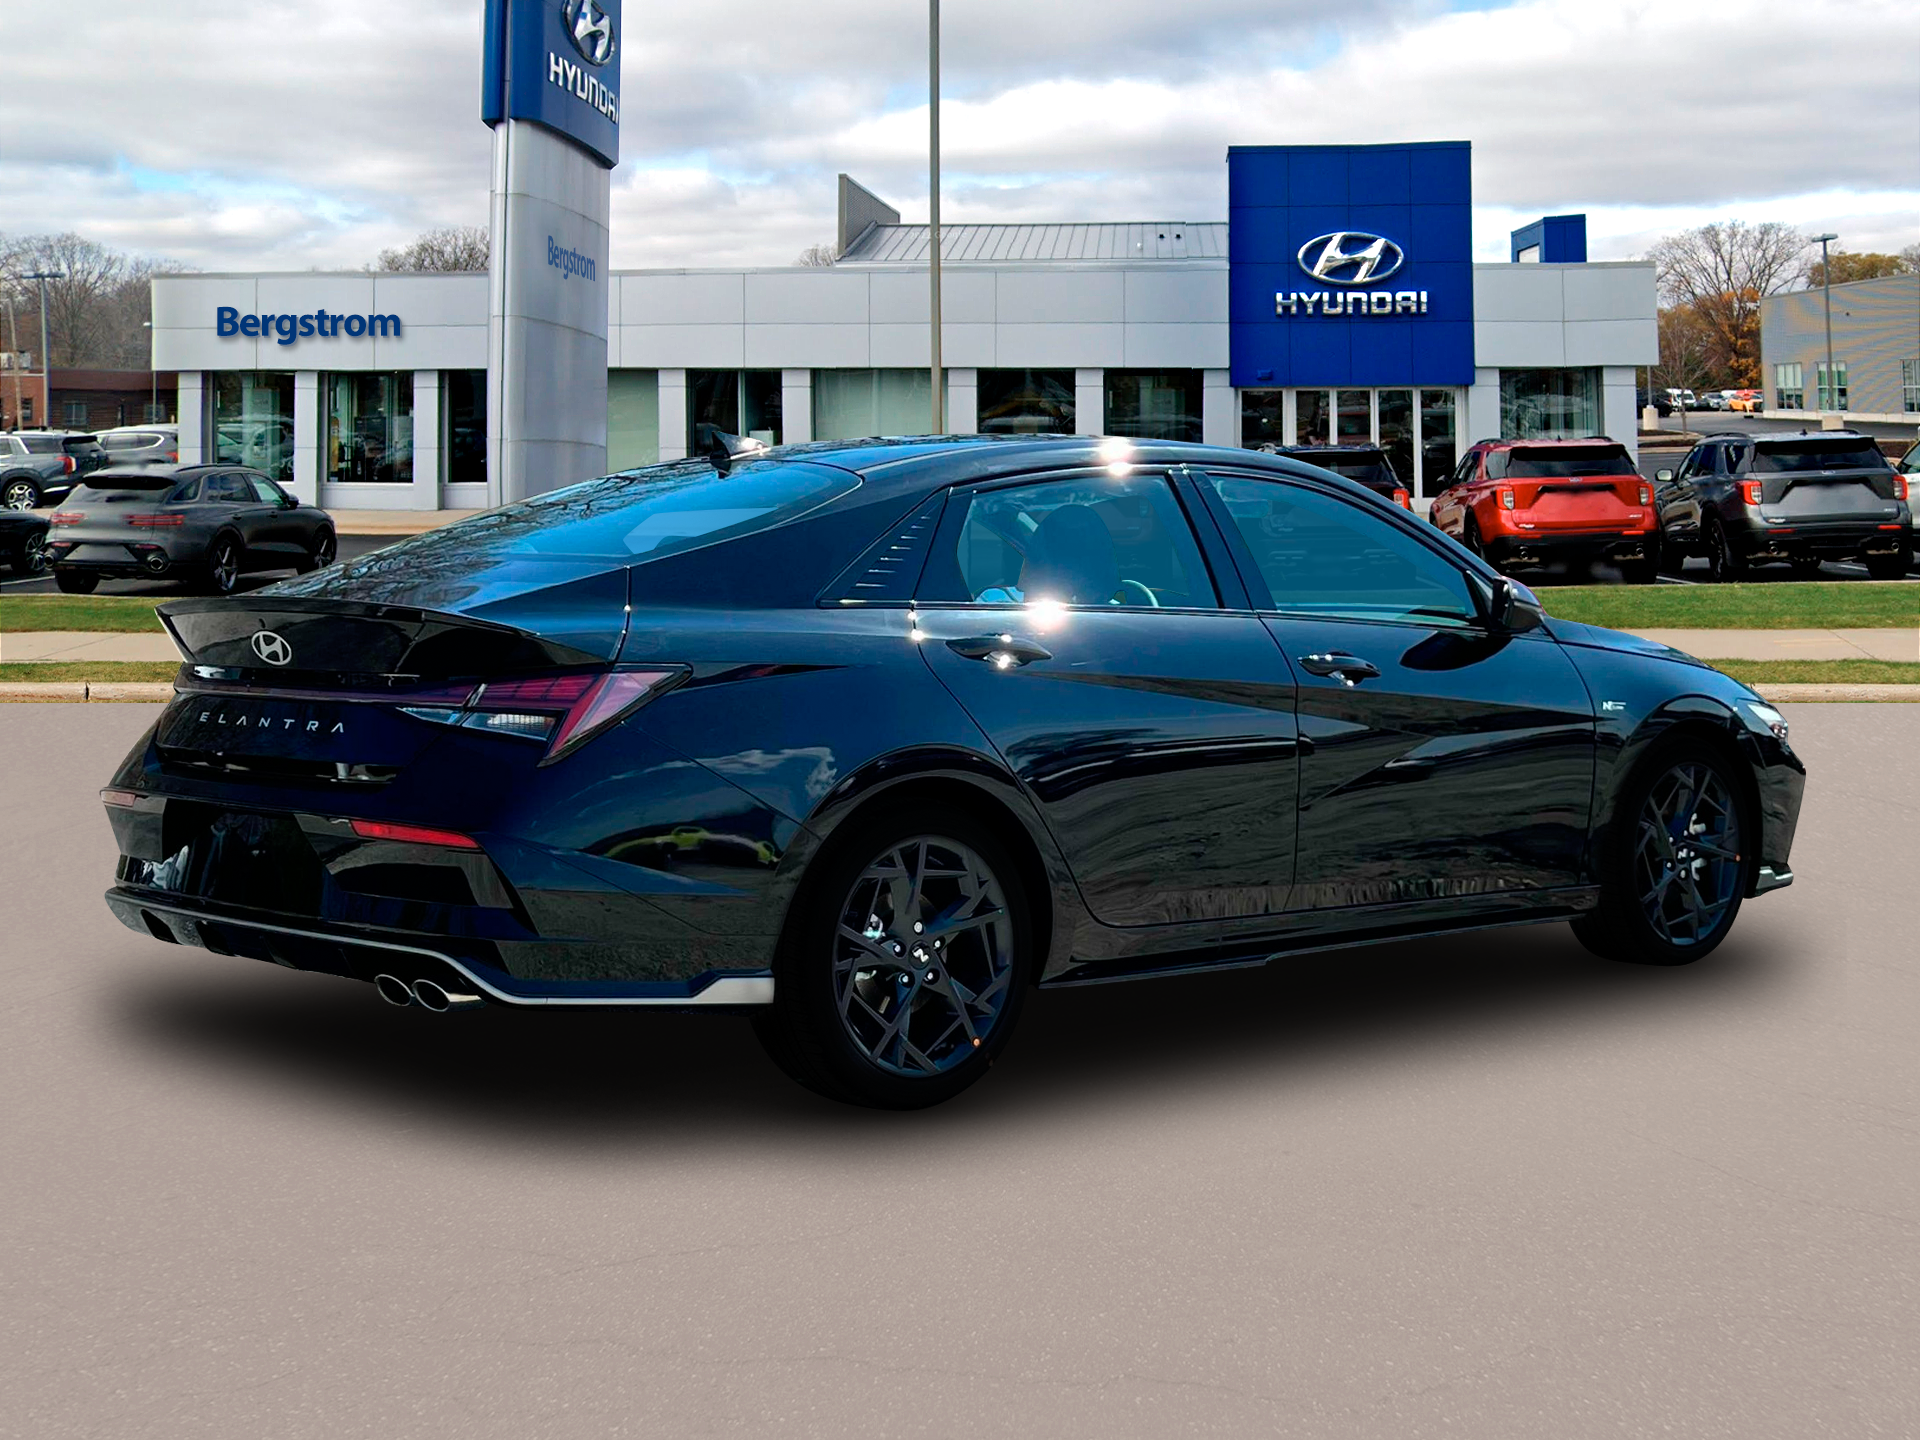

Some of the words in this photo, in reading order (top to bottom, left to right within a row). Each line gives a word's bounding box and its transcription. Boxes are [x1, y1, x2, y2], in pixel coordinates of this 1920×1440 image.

[549, 52, 619, 124] HYUNDAI
[547, 235, 596, 282] Bergstrom
[1275, 291, 1428, 315] HYUNDAI
[217, 306, 401, 346] Bergstrom
[199, 711, 345, 733] ELANTRA
